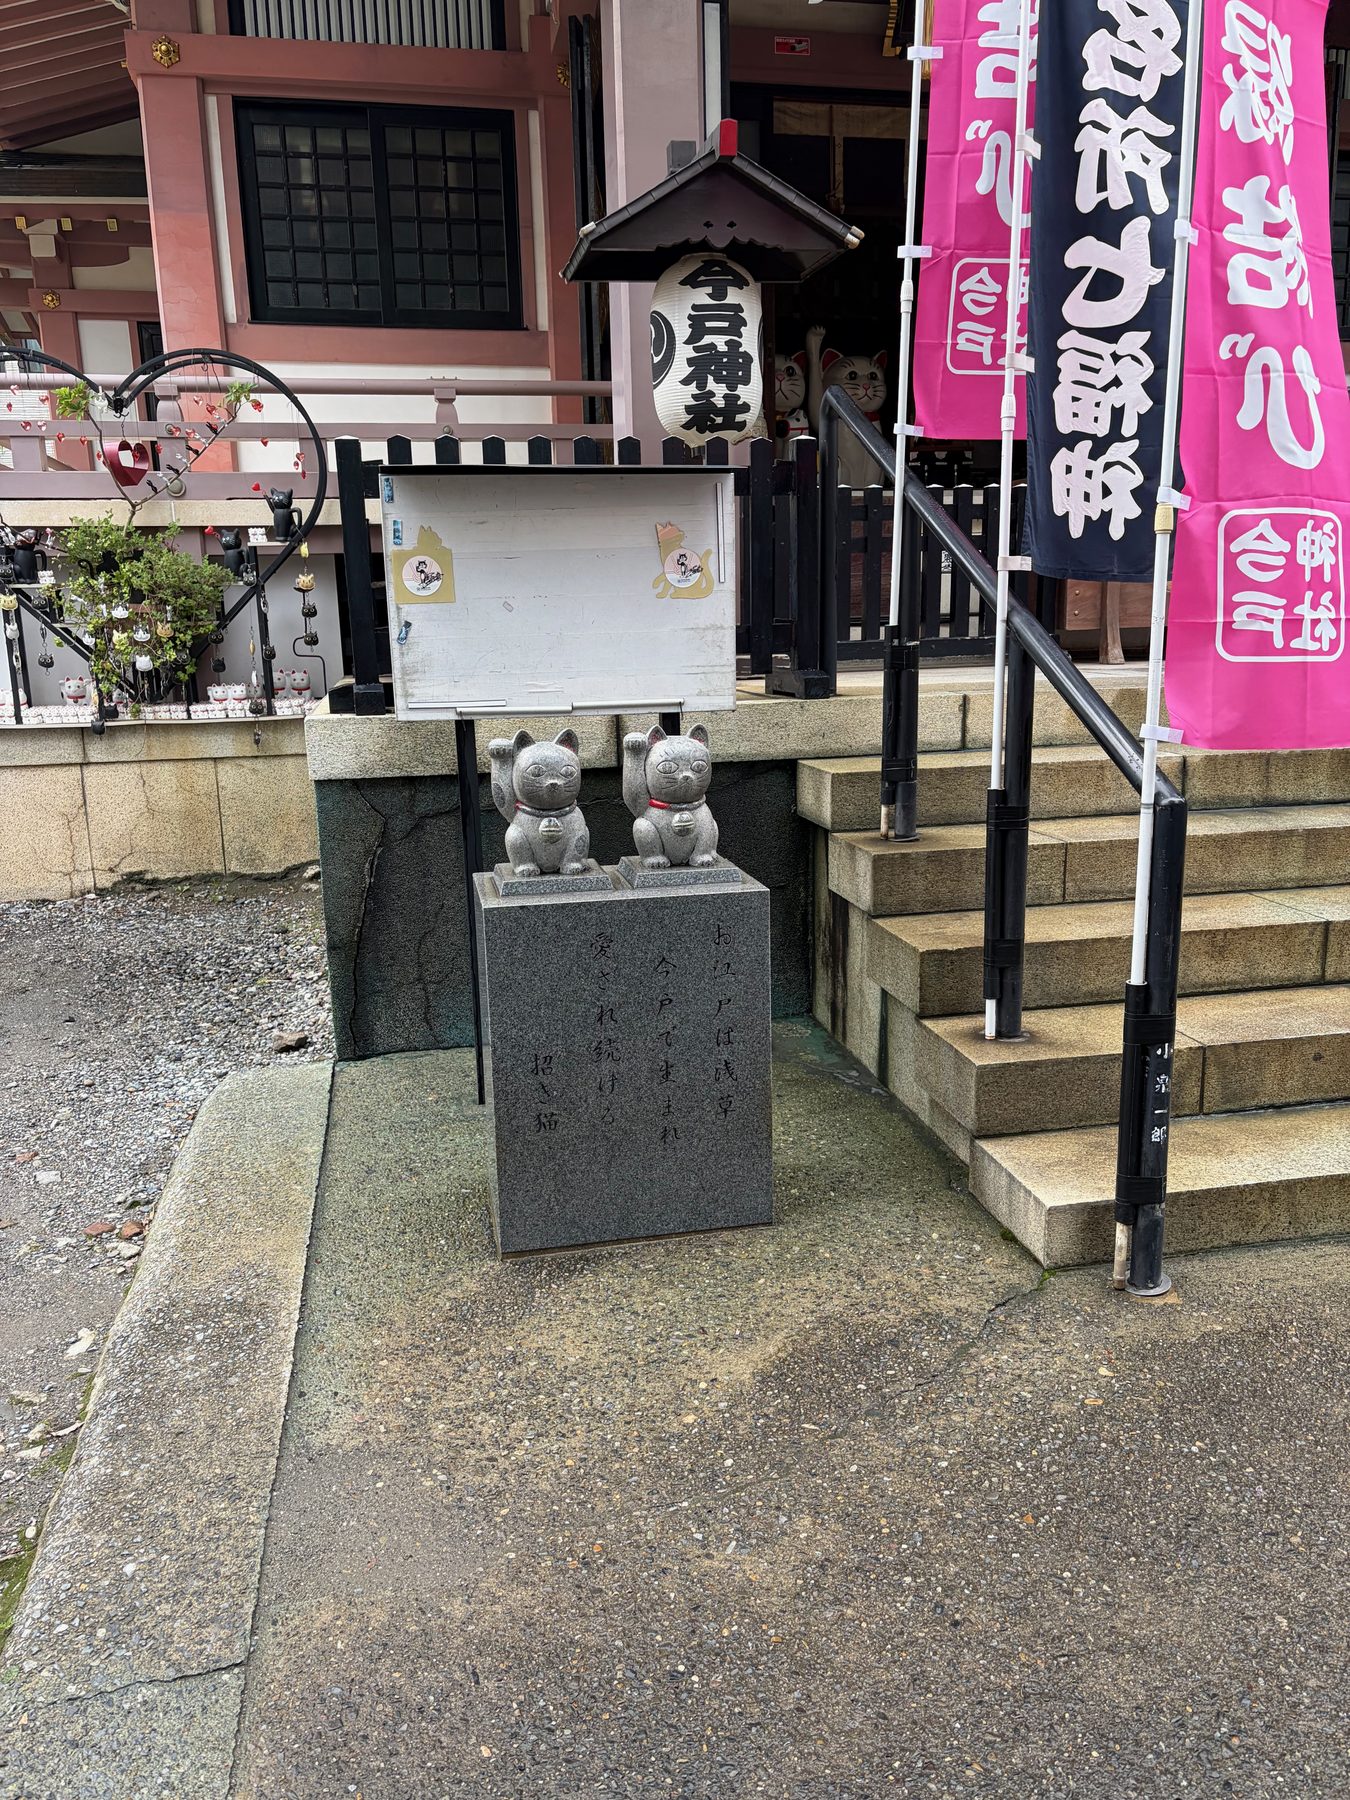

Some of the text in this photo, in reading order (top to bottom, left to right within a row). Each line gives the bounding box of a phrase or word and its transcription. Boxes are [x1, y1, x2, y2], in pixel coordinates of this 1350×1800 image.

[679, 259, 754, 434] 今戸神社
[530, 1053, 557, 1133] 招き猫
[589, 931, 621, 1127] 愛され続ける
[653, 956, 681, 1142] 今戸で生まれ
[712, 923, 739, 1120] お江戸は浅草
